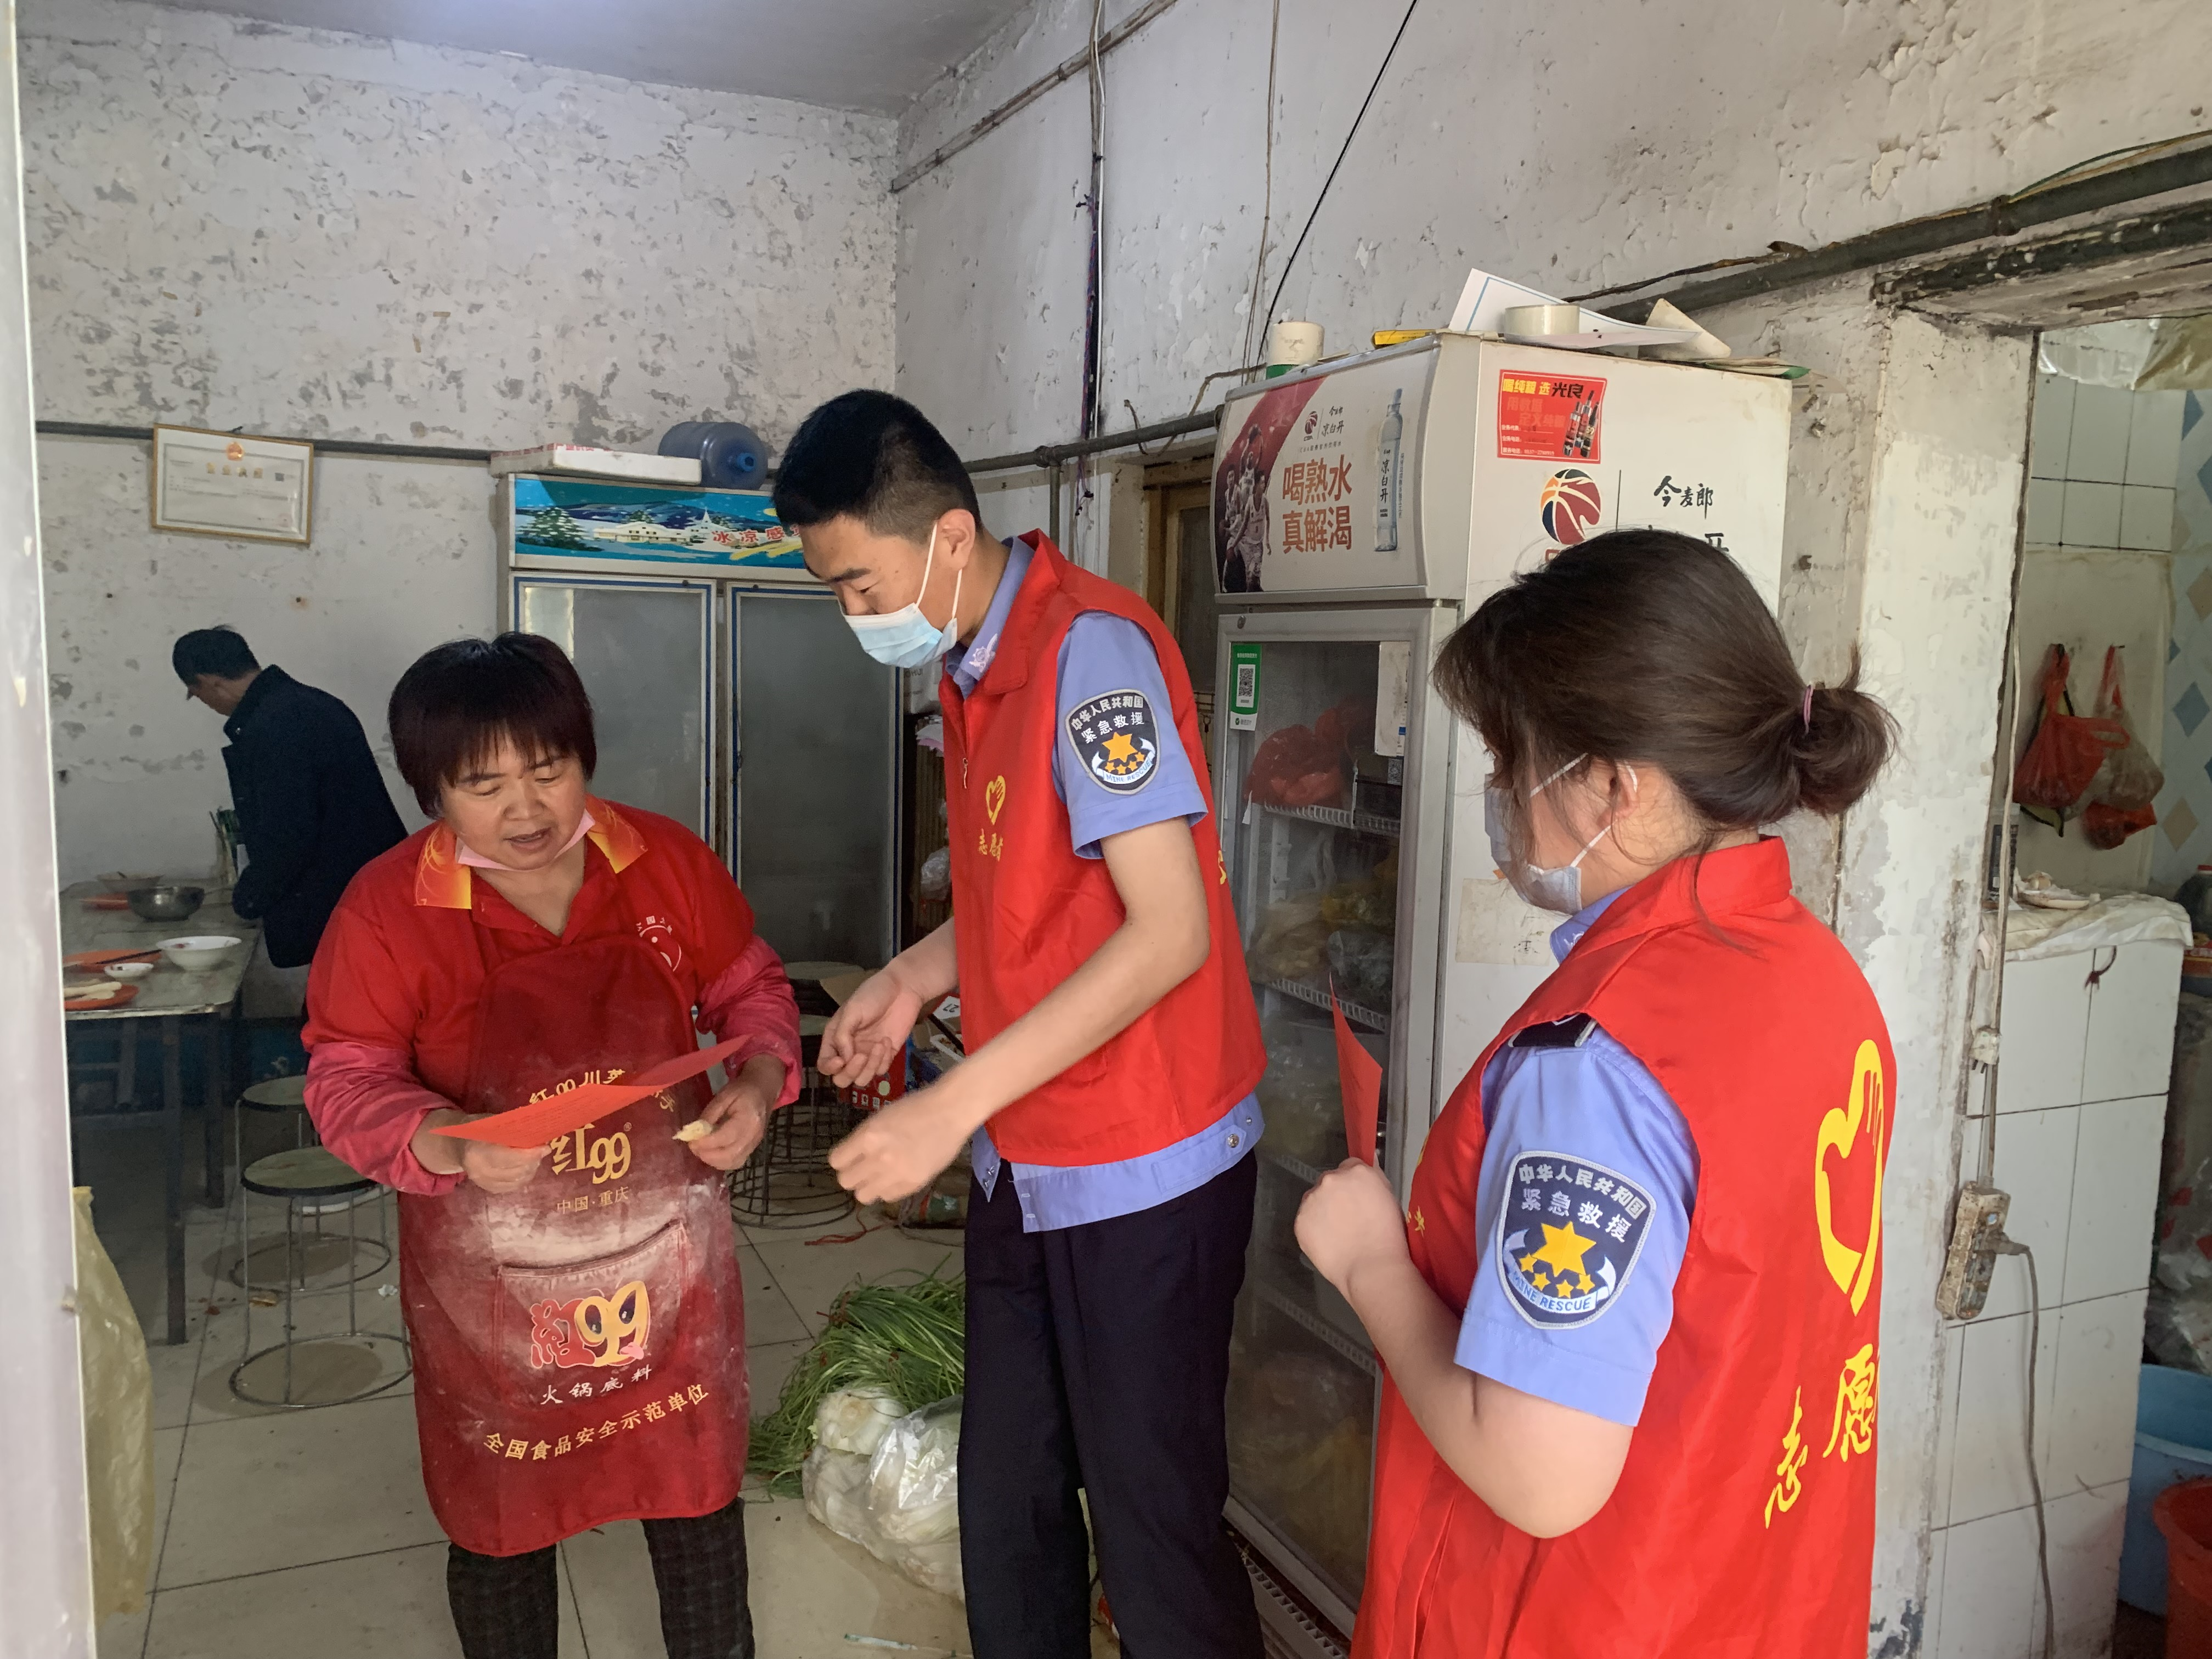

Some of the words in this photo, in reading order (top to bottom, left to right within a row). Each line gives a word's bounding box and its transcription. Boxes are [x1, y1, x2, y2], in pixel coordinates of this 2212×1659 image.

[1282, 454, 1352, 505] 喝熟水
[1654, 475, 1714, 520] 今麦郎
[1282, 505, 1352, 554] 真解渴
[1071, 695, 1144, 731] 中华人民共和国
[1081, 712, 1145, 744] 紧急救援
[1127, 759, 1152, 781] RESCUE
[1518, 1163, 1647, 1220] 中华人民共和国
[1521, 1188, 1632, 1243] 紧急救援
[1511, 1269, 1537, 1302] MINE
[1540, 1296, 1592, 1312] RESCUE
[540, 1364, 653, 1406] 火锅底料
[483, 1384, 709, 1460] 全国食品安全示范单位
[1764, 1343, 1880, 1530] 志愿
